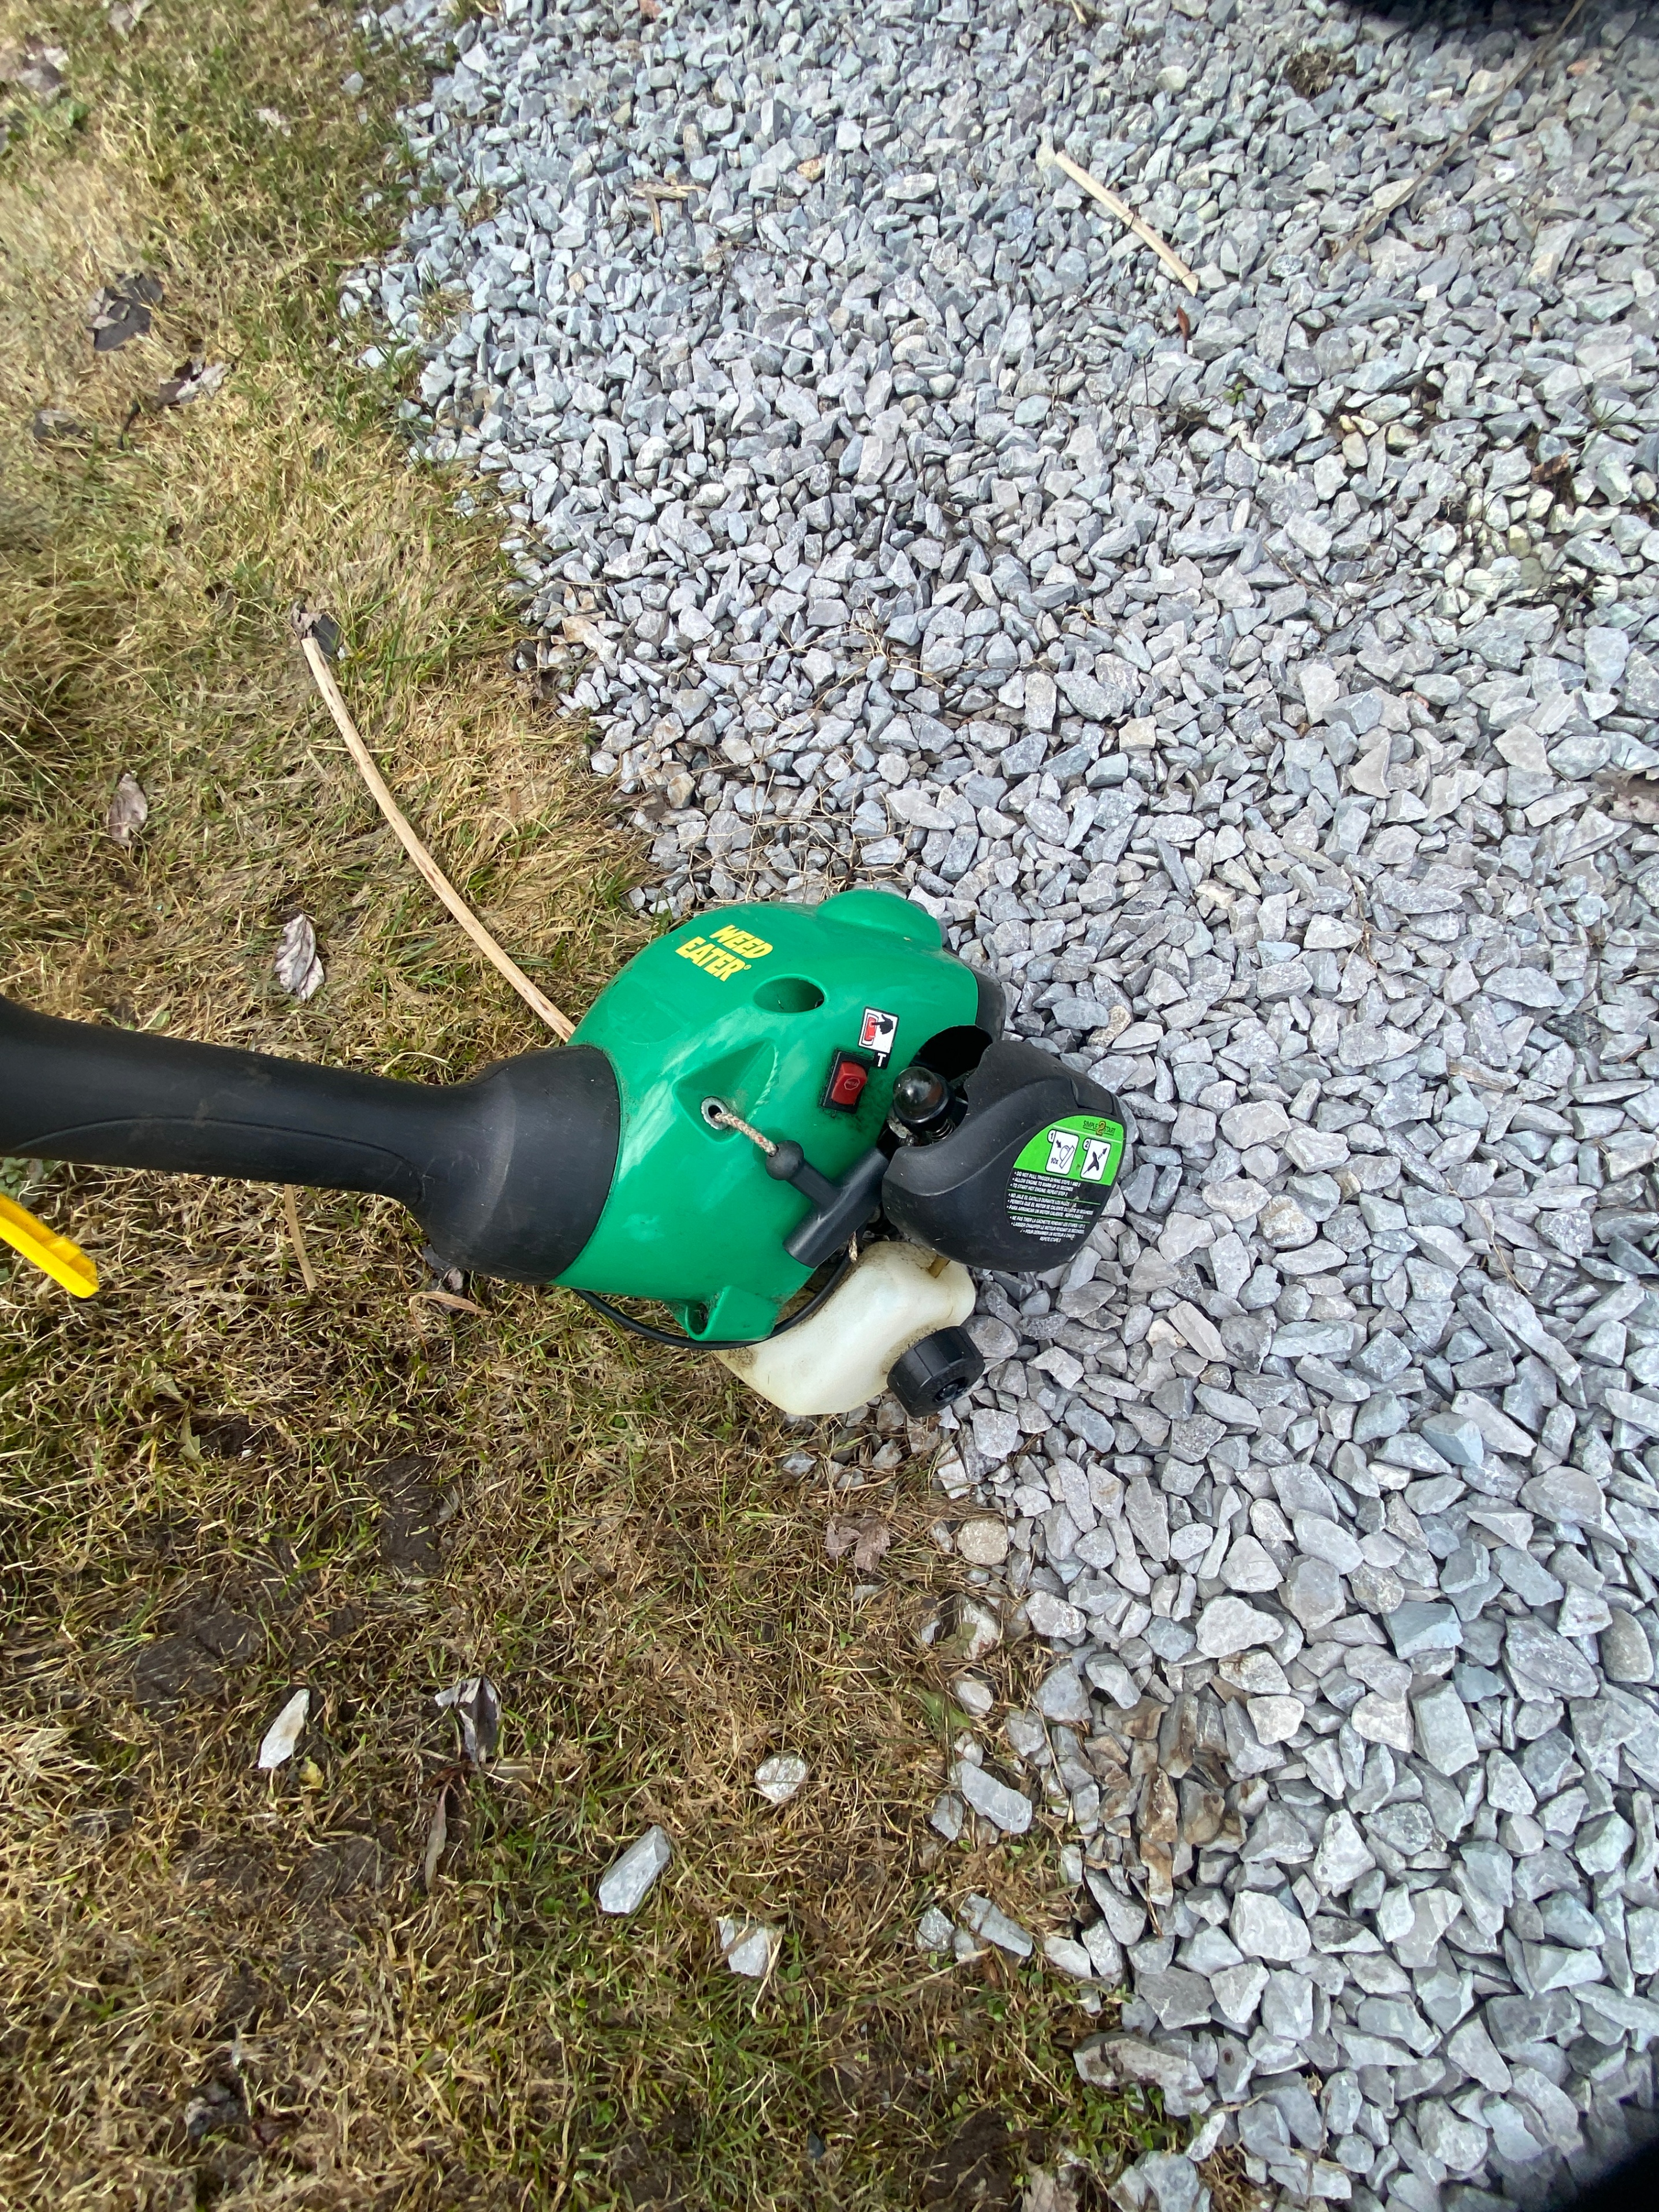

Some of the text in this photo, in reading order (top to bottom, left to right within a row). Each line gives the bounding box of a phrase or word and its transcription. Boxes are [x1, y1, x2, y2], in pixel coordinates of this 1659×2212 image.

[709, 925, 773, 959] WEED
[675, 936, 746, 982] EATER
[877, 1052, 887, 1067] T
[1096, 1120, 1106, 1136] 2
